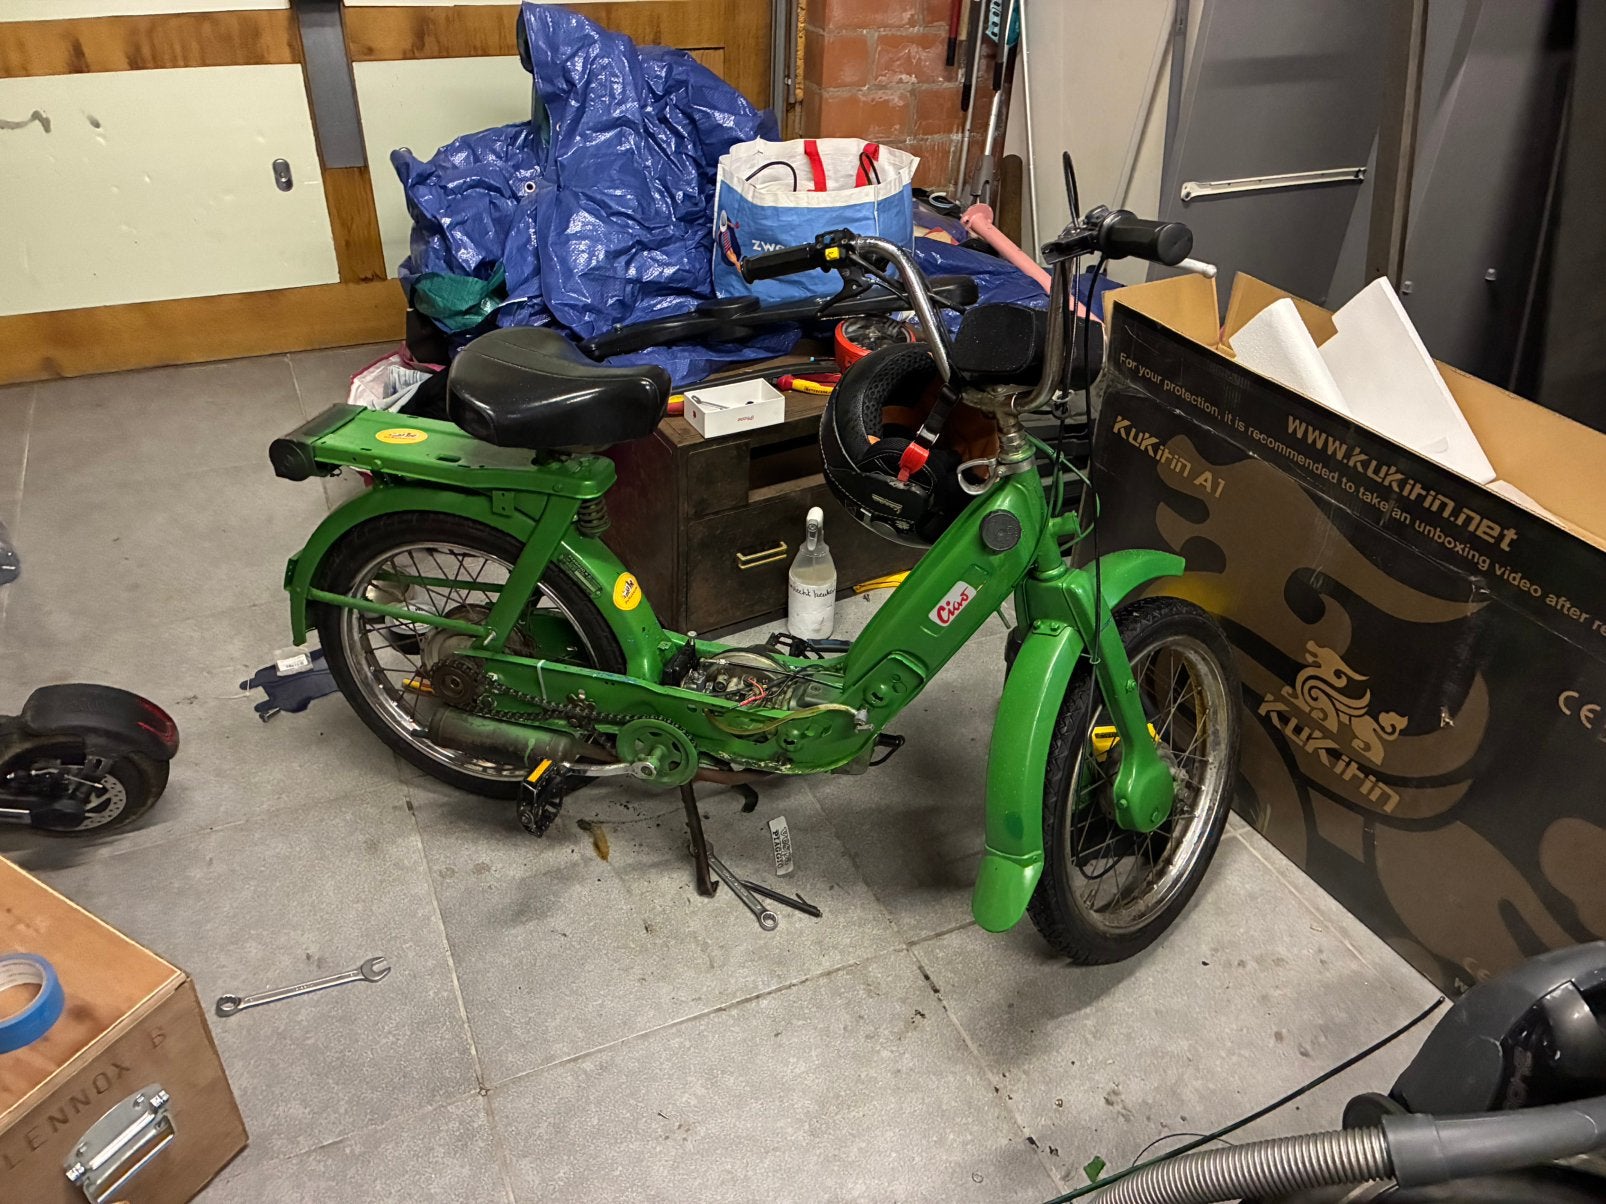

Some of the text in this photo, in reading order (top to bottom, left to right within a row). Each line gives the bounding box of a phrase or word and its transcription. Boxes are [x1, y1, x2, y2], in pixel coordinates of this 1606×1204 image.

[1119, 352, 1137, 370] For
[1138, 363, 1162, 382] your
[1163, 379, 1221, 419] protection,
[1224, 410, 1232, 425] it
[1235, 416, 1245, 432] is
[1248, 426, 1339, 484] recommended
[1341, 476, 1355, 493] to
[1358, 486, 1389, 512] take
[1391, 507, 1411, 525] an
[1414, 519, 1491, 570] unboxing
[1494, 562, 1542, 598] video
[1546, 593, 1590, 623] after
[1193, 470, 1226, 498] A1
[937, 586, 969, 625] Ciao
[1558, 690, 1601, 730] CE
[772, 829, 784, 869] PIAGGIO
[1, 1060, 132, 1171] LENNOX
